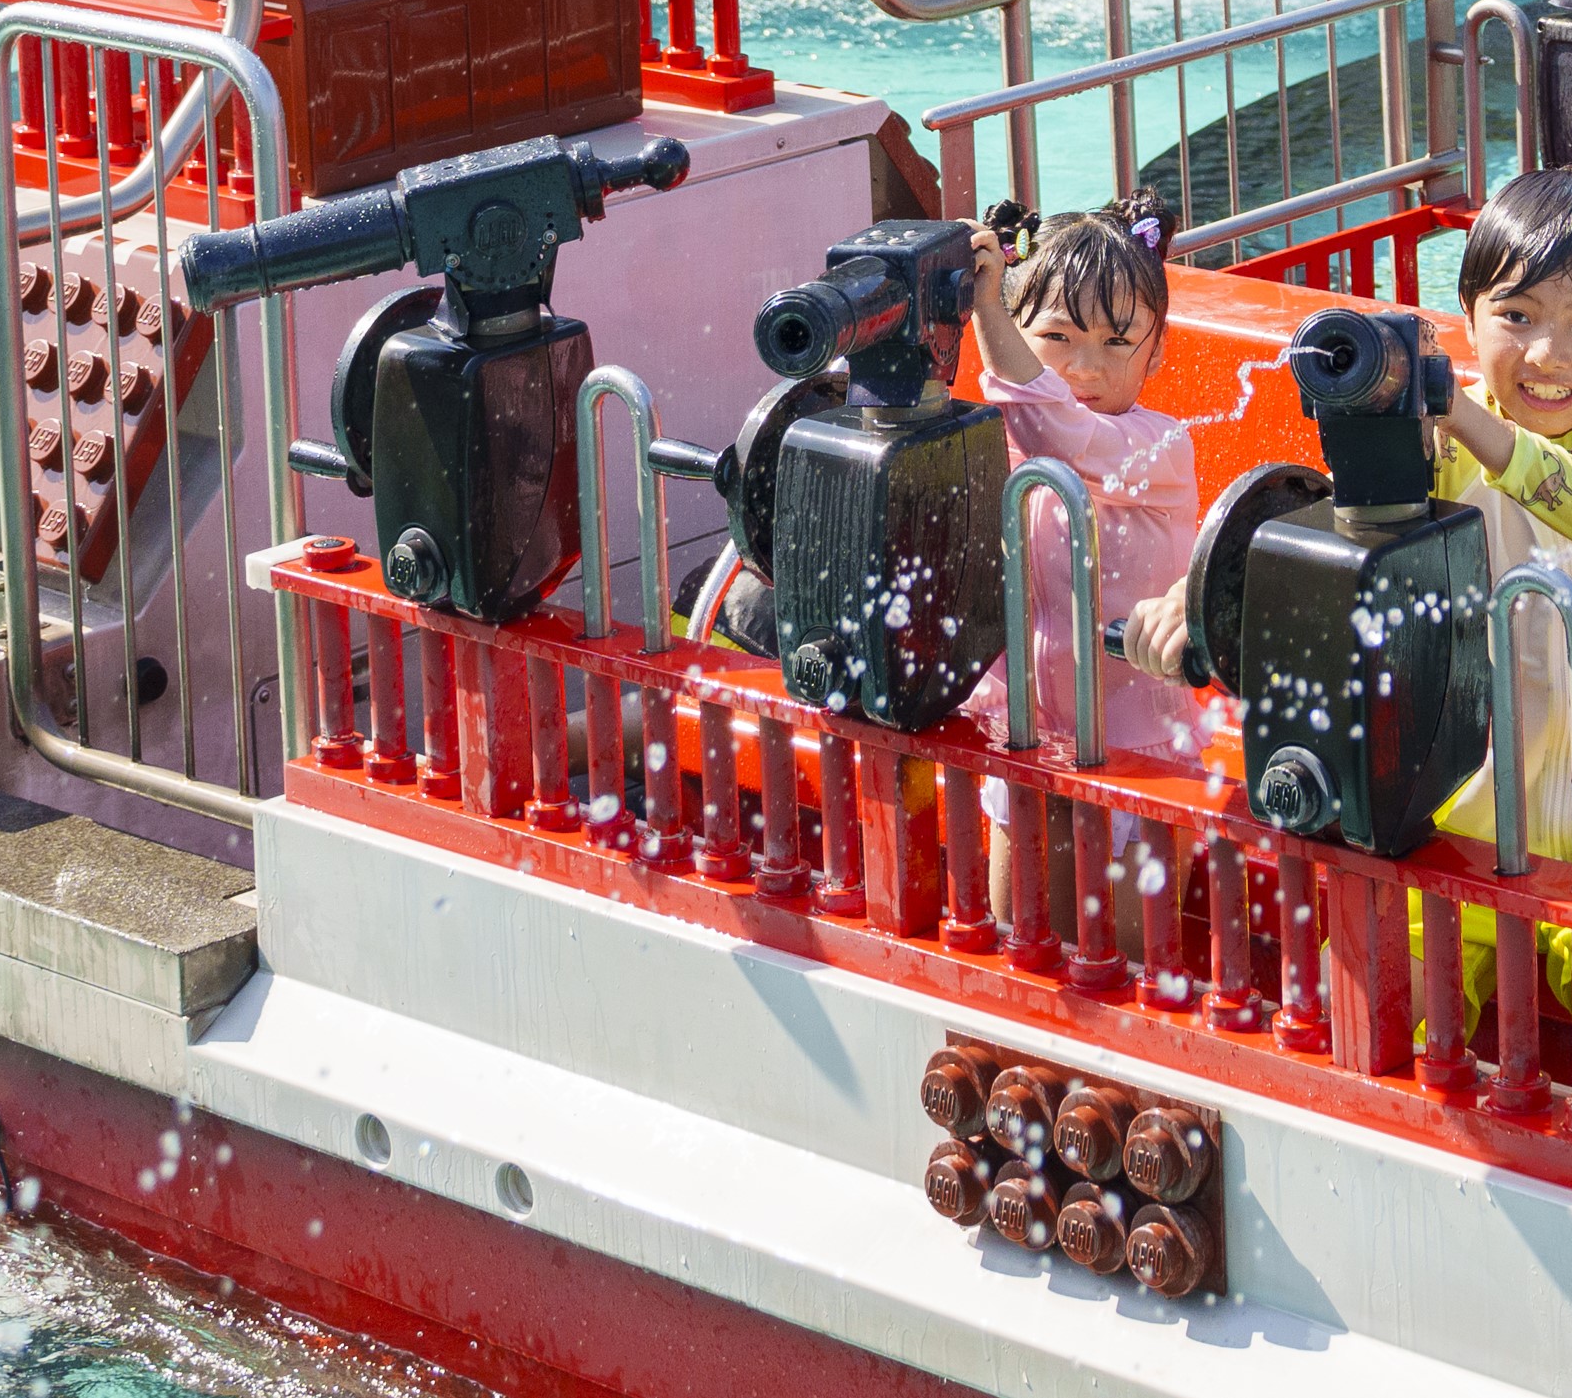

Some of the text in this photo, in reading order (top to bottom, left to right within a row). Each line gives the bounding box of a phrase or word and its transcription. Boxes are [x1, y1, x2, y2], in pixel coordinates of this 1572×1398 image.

[29, 429, 59, 452] LEGO
[73, 440, 104, 464] LEGO
[390, 550, 417, 585] LEGO
[796, 656, 826, 689] LEGO
[1265, 779, 1298, 814] LEGO
[923, 1082, 956, 1117] LEGO
[1058, 1124, 1090, 1161] LEGO
[1128, 1148, 1161, 1182] LEGO
[928, 1173, 959, 1208] LEGO
[994, 1196, 1026, 1230] LEGO
[1063, 1218, 1094, 1252] LEGO
[1132, 1240, 1163, 1276] LEGO
